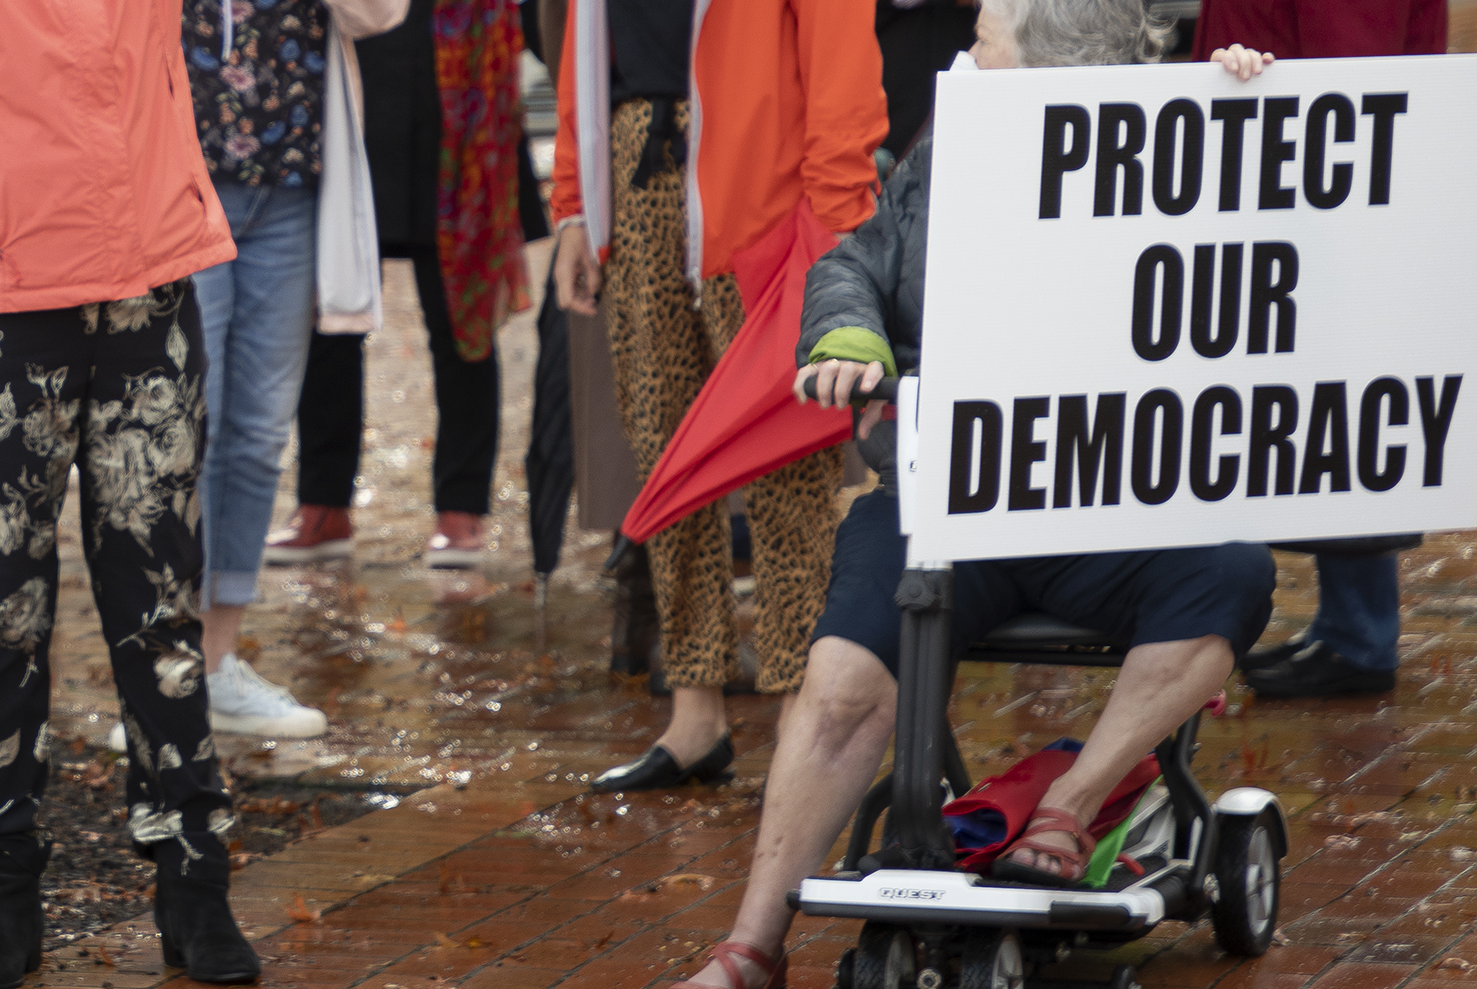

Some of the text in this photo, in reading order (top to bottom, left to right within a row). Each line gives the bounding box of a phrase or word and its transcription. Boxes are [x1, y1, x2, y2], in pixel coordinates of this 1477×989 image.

[1038, 92, 1409, 220] PROTECT
[1131, 241, 1300, 362] OUR
[947, 374, 1464, 515] DEMOCRACY
[879, 887, 946, 900] QUEST
